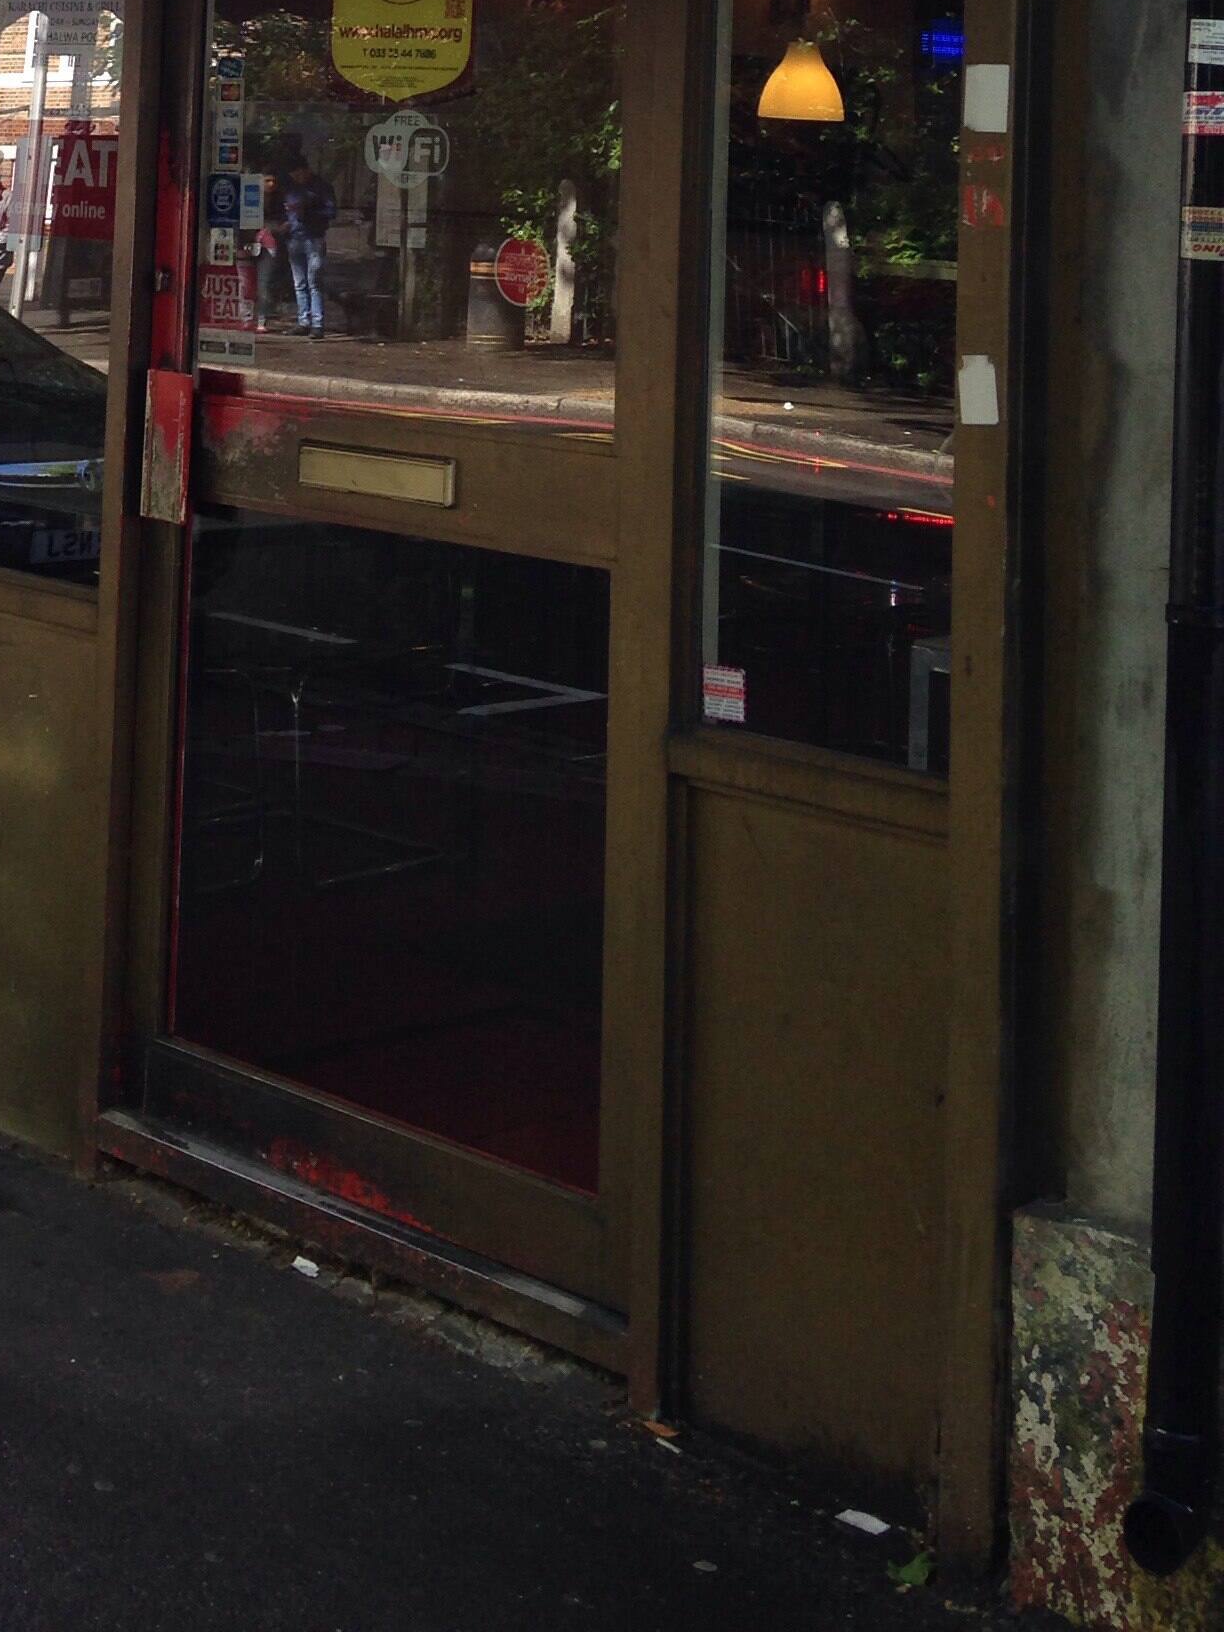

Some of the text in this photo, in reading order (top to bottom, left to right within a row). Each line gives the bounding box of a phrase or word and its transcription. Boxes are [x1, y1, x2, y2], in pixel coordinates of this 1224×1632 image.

[393, 114, 421, 127] FREE
[62, 200, 106, 220] online
[201, 274, 242, 298] JUST
[212, 297, 242, 322] EAT
